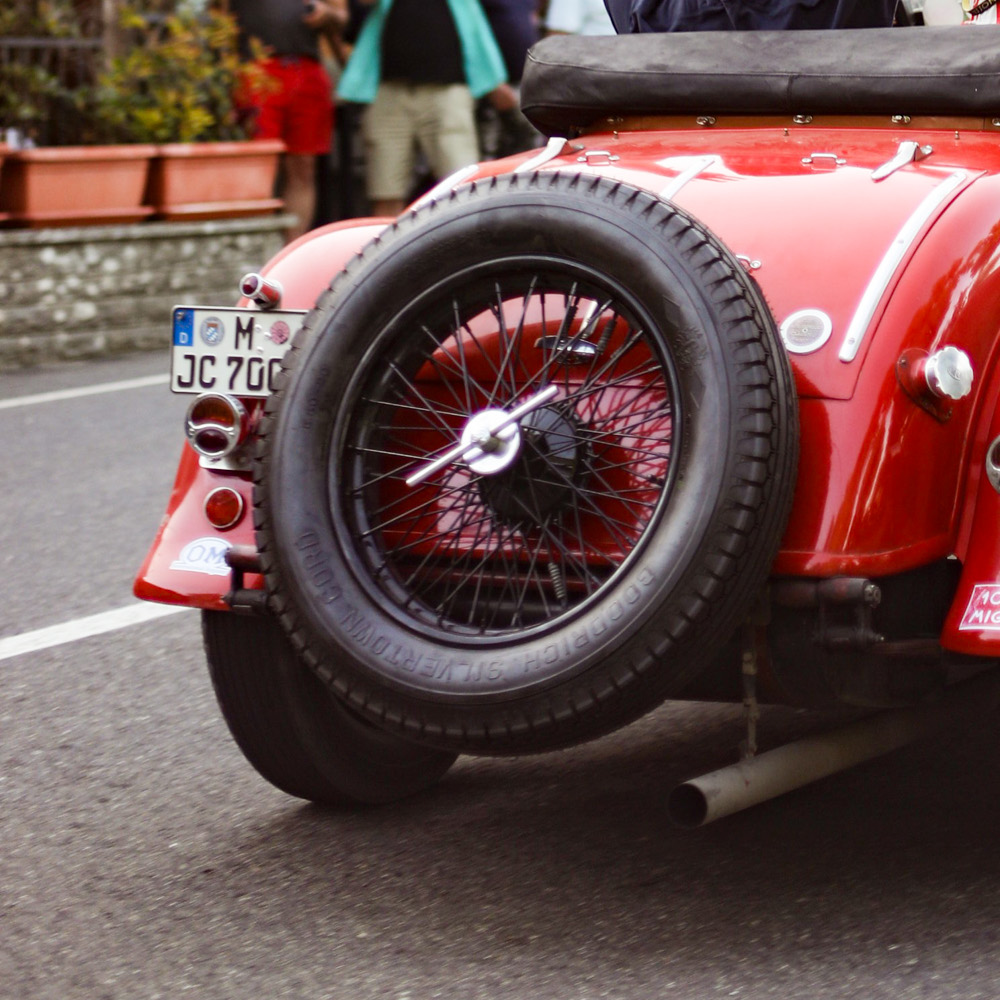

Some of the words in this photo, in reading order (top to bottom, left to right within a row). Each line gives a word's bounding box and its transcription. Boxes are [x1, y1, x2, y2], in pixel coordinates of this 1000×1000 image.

[179, 332, 189, 344] D
[234, 315, 255, 350] M
[177, 354, 217, 389] JC
